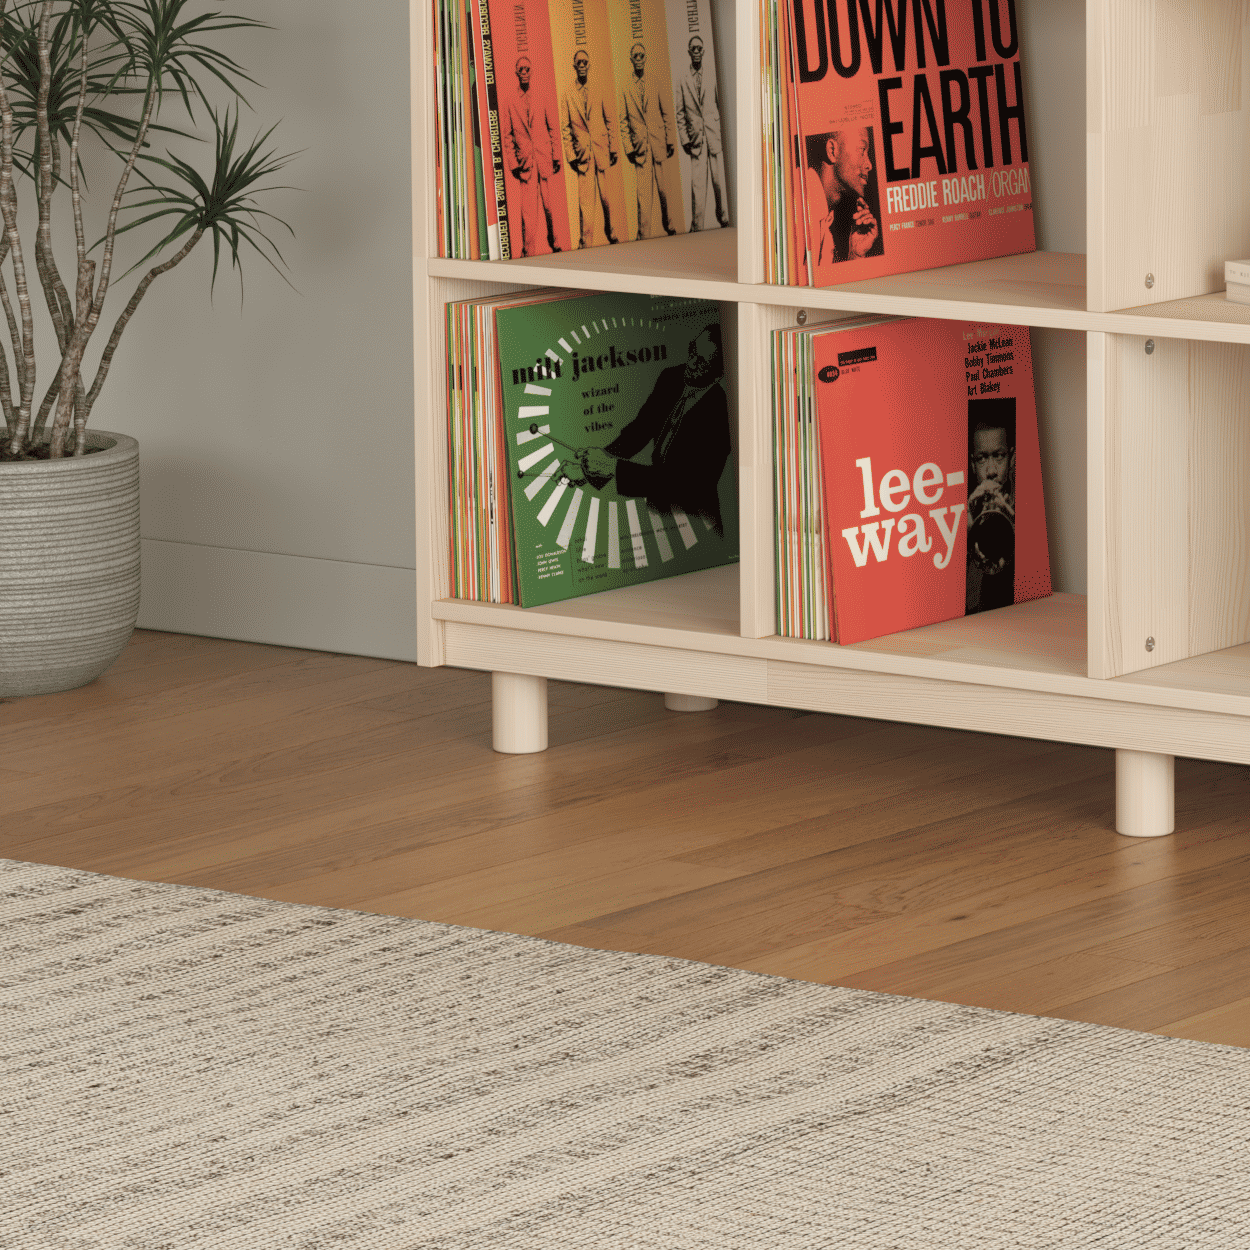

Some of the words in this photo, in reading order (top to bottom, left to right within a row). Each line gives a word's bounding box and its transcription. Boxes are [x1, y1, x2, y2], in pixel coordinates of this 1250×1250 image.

[877, 61, 1029, 183] EARTH
[886, 180, 939, 214] FREDDIE
[967, 340, 988, 355] Jackie
[988, 337, 1014, 351] McLean
[511, 356, 562, 386] milt
[571, 344, 668, 382] jackson
[964, 355, 984, 369] Bobby
[984, 352, 1015, 366] Timmons
[965, 369, 980, 383] Paul
[982, 364, 1014, 380] Chambers
[581, 382, 620, 400] wizard
[967, 384, 978, 397] Art
[979, 381, 1001, 395] Blakey
[582, 403, 595, 417] of
[597, 402, 615, 415] the
[583, 419, 614, 434] vibes
[855, 456, 965, 519] lee-
[841, 503, 966, 570] way
